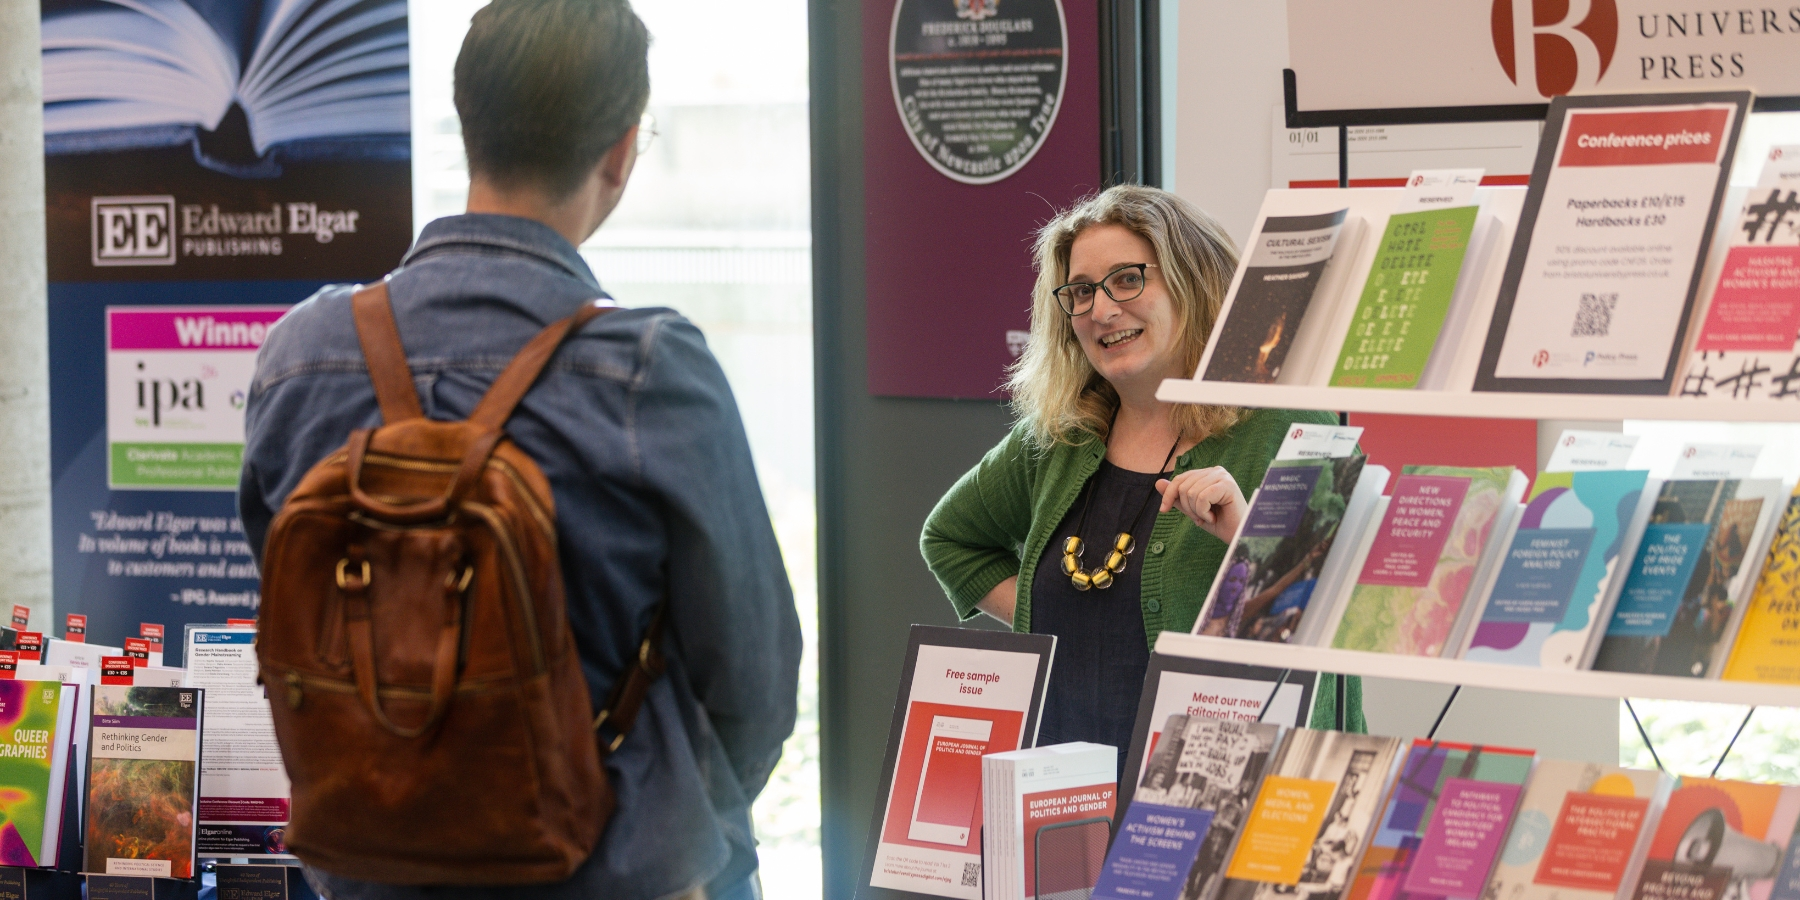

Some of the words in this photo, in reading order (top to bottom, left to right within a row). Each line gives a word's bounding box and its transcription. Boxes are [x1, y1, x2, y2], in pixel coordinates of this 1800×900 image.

[1640, 52, 1745, 80] PRESS
[1289, 128, 1319, 148] 01/01
[1577, 132, 1663, 148] Conference
[1663, 129, 1711, 150] prices
[936, 144, 1002, 175] Newcastle
[1567, 198, 1638, 211] Paperbacks
[181, 203, 283, 236] Edward
[287, 202, 359, 243] Elgar
[1576, 216, 1641, 227] Hardbacks
[99, 205, 169, 257] EE
[182, 237, 283, 256] PUBLISHING
[137, 361, 205, 427] ipa
[1419, 486, 1440, 495] NEW
[1399, 495, 1452, 507] DIRECTIONS
[1395, 507, 1407, 515] IN
[198, 516, 226, 533] was
[1392, 517, 1420, 527] PEACE
[1421, 519, 1441, 528] AND
[1390, 528, 1433, 538] SECURITY
[1664, 534, 1681, 544] THE
[79, 533, 96, 553] Its
[98, 533, 149, 553] volume
[152, 535, 167, 558] of
[170, 535, 207, 555] books
[210, 535, 222, 555] is
[1530, 539, 1570, 548] FEMINIST
[1648, 544, 1687, 555] POLITICS
[1522, 560, 1561, 569] ANALYSIS
[1644, 555, 1657, 565] OF
[1658, 555, 1684, 565] PRIDE
[108, 560, 123, 575] to
[126, 562, 195, 577] customers
[197, 558, 226, 578] and
[1642, 565, 1677, 576] EVENTS
[945, 669, 965, 680] Free
[966, 671, 1000, 684] sample
[959, 683, 983, 695] issue
[1192, 692, 1219, 703] Meet
[1220, 697, 1237, 706] our
[1240, 699, 1261, 709] new
[1186, 706, 1230, 720] Editorial
[14, 729, 49, 744] QUEER
[101, 732, 140, 743] Rethinking
[141, 734, 167, 742] Gender
[101, 743, 115, 751] and
[116, 743, 142, 752] Politics
[937, 740, 960, 748] EUROPEAN
[1030, 797, 1067, 809] EUROPEAN
[1069, 793, 1100, 803] JOURNAL
[1102, 791, 1112, 799] OF
[1295, 802, 1314, 812] AND
[1030, 807, 1060, 818] POLITICS
[1062, 805, 1077, 814] AND
[1080, 801, 1107, 812] GENDER
[1146, 814, 1186, 828] WOMEN'S
[1125, 823, 1165, 836] ACTIVISM
[1165, 827, 1197, 840] BEHIND
[1130, 834, 1147, 846] THE
[1147, 837, 1183, 850] SCREENS
[1661, 871, 1705, 886] BEYOND
